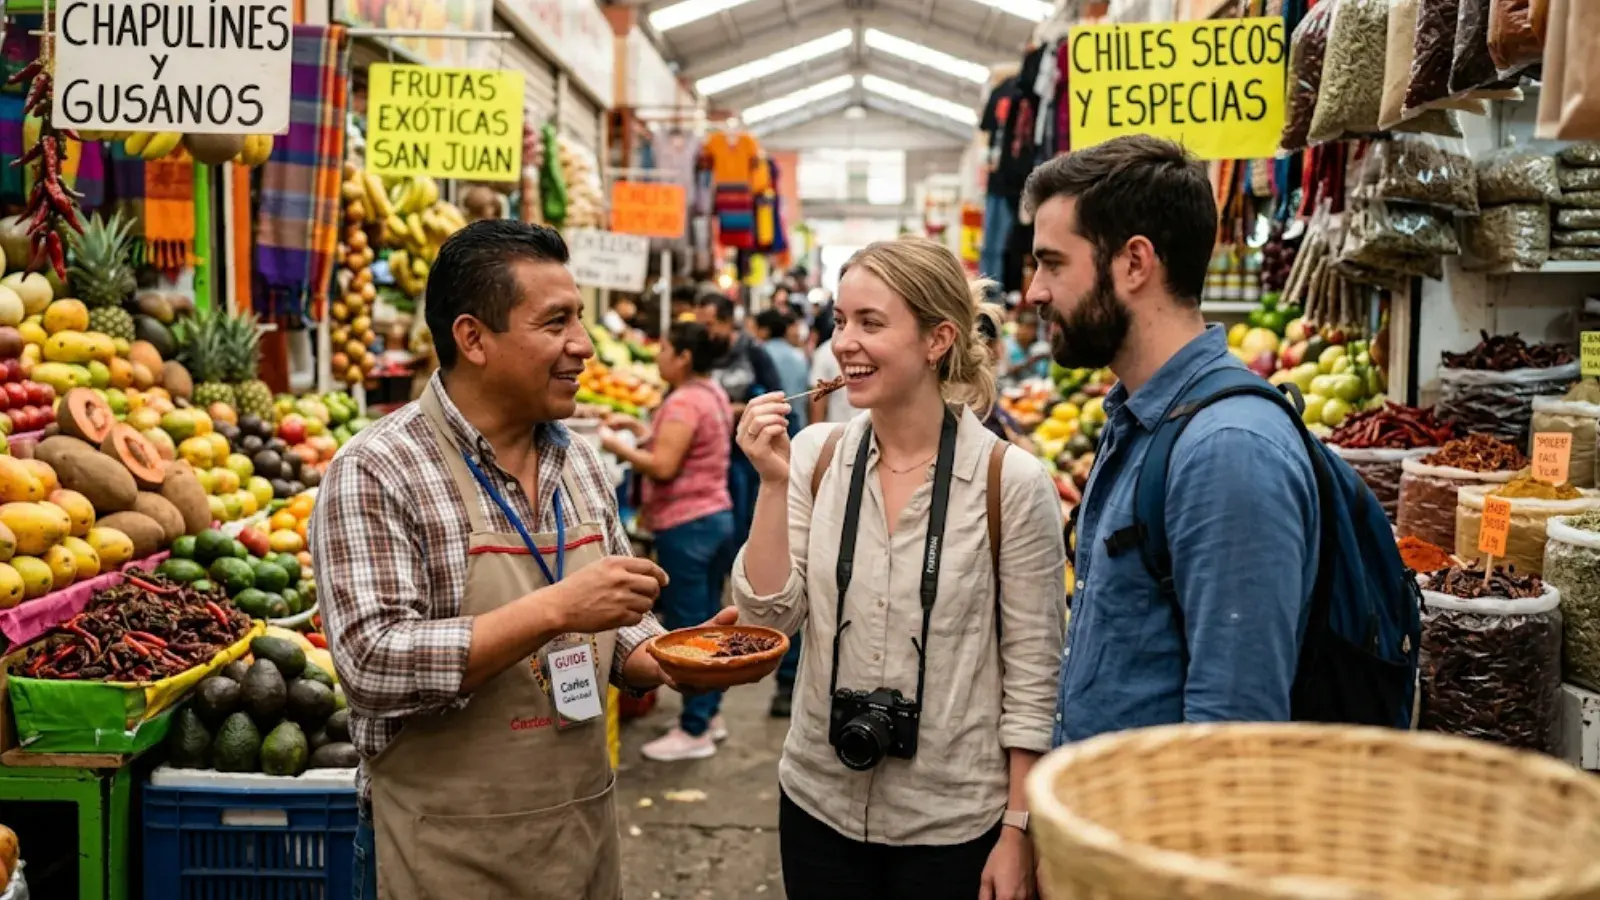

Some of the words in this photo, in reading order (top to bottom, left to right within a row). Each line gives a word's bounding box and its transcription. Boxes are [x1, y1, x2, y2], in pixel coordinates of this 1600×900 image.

[62, 0, 289, 50] CHAPULINES
[1072, 26, 1177, 73] CHILES
[1191, 21, 1285, 68] SECOS
[62, 79, 264, 126] GUSANOS
[390, 70, 497, 101] FRUTAS
[1075, 89, 1093, 127] Y
[1107, 77, 1268, 127] ESPECIAS
[378, 100, 509, 136] EXÓTICAS
[373, 139, 430, 170] SAN
[441, 141, 513, 173] JUAN
[555, 651, 588, 669] GUIDE
